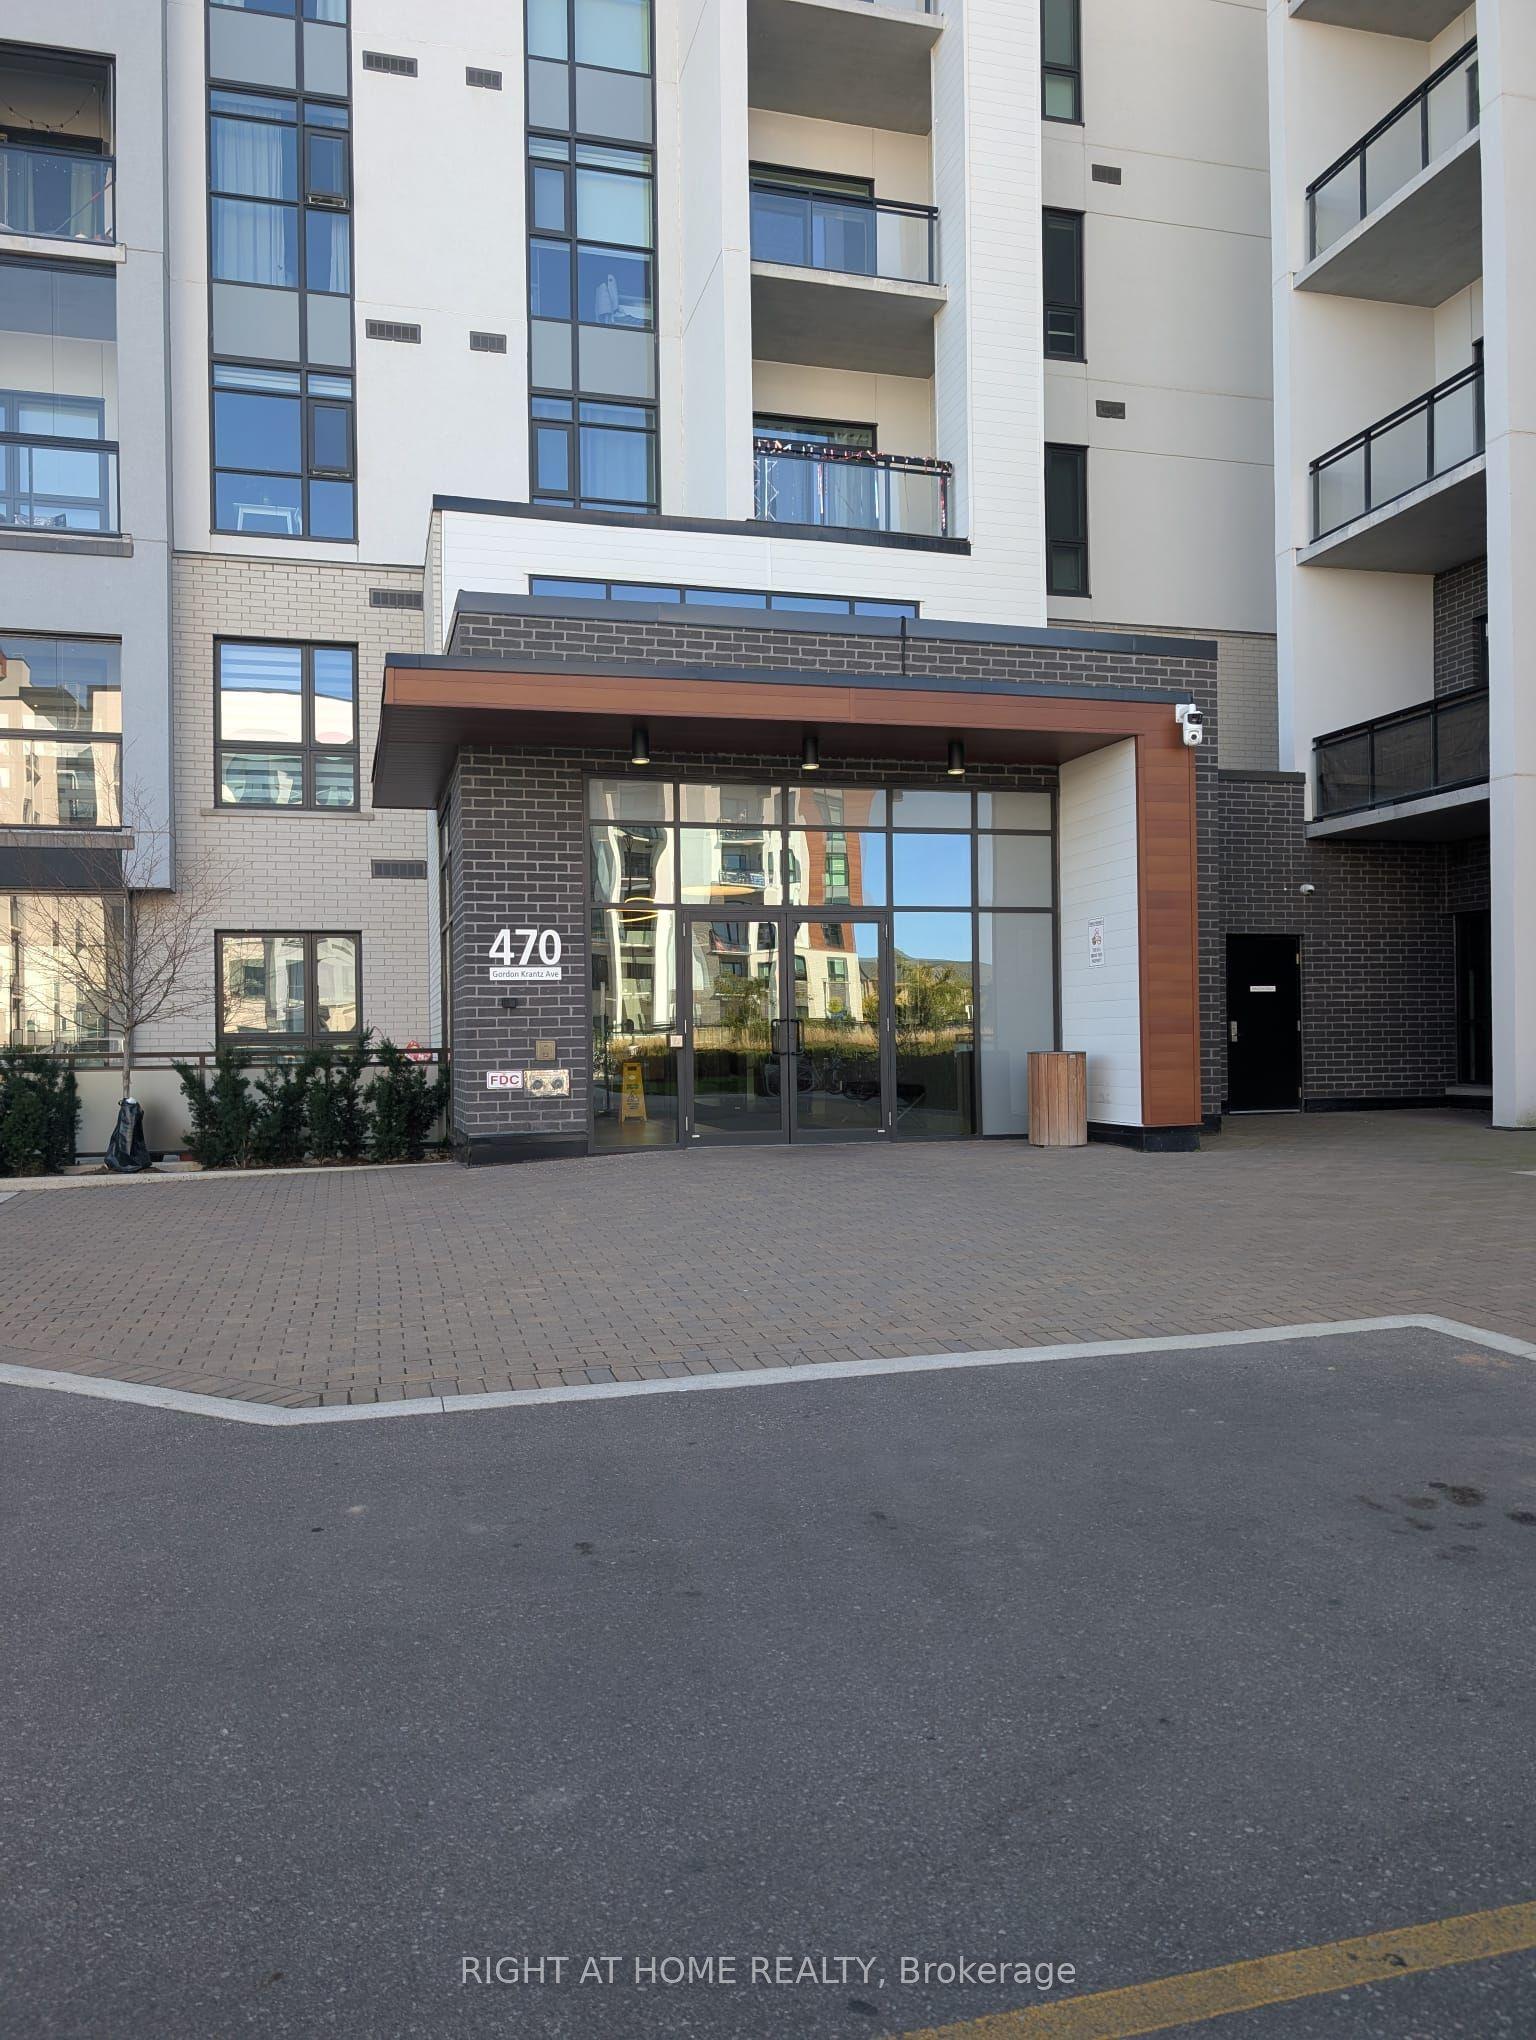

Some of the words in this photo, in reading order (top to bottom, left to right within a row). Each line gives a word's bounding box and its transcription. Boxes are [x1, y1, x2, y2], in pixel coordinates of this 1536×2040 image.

[488, 929, 562, 966] 470
[492, 970, 519, 978] Gordon
[521, 970, 544, 978] Krantz
[545, 970, 559, 978] Ave
[490, 1075, 520, 1085] FDC
